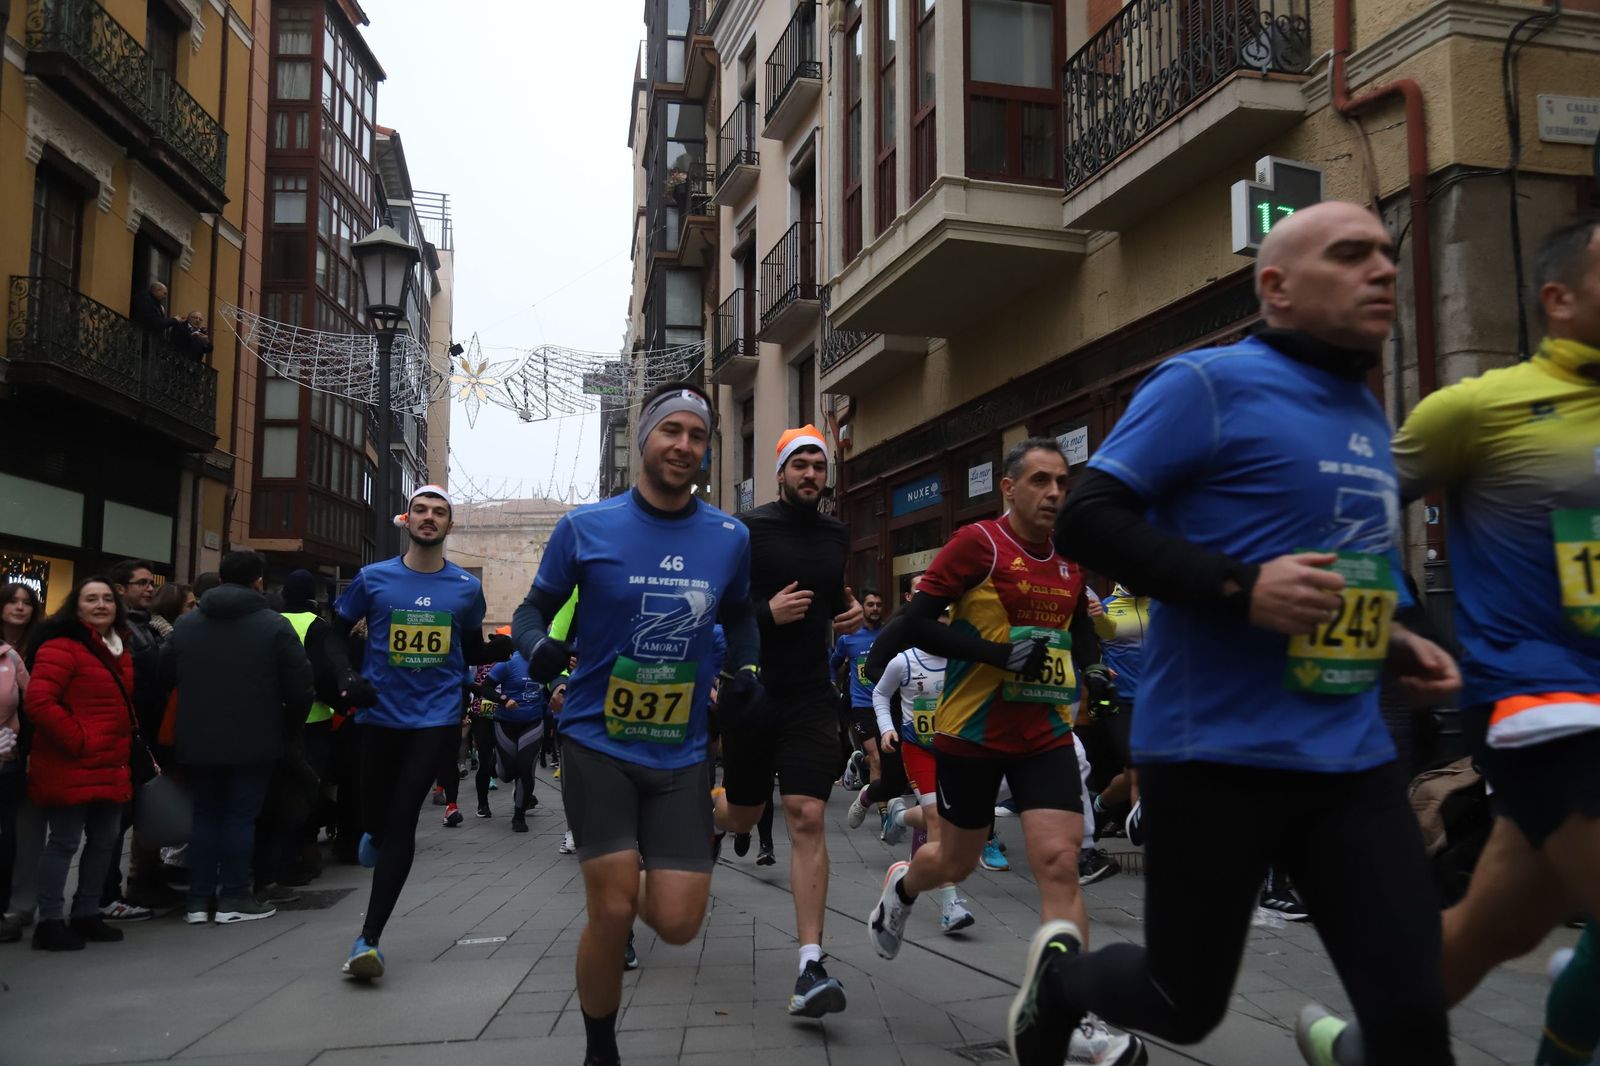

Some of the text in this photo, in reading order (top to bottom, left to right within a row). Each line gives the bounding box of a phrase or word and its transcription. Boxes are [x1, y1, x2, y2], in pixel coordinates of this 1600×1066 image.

[1070, 434, 1086, 447] mer
[979, 467, 992, 478] mer
[907, 486, 930, 502] NUXE
[659, 555, 685, 571] 46
[1572, 546, 1600, 595] 1
[629, 576, 646, 584] SAN
[647, 577, 690, 587] SILVESTRE
[414, 596, 432, 607] 46
[1030, 600, 1058, 611] VINO
[1016, 609, 1033, 619] DE
[393, 629, 442, 653] 846
[641, 642, 679, 653] AMORA
[611, 687, 684, 722] 937
[625, 727, 682, 738] CAJA RURAL
